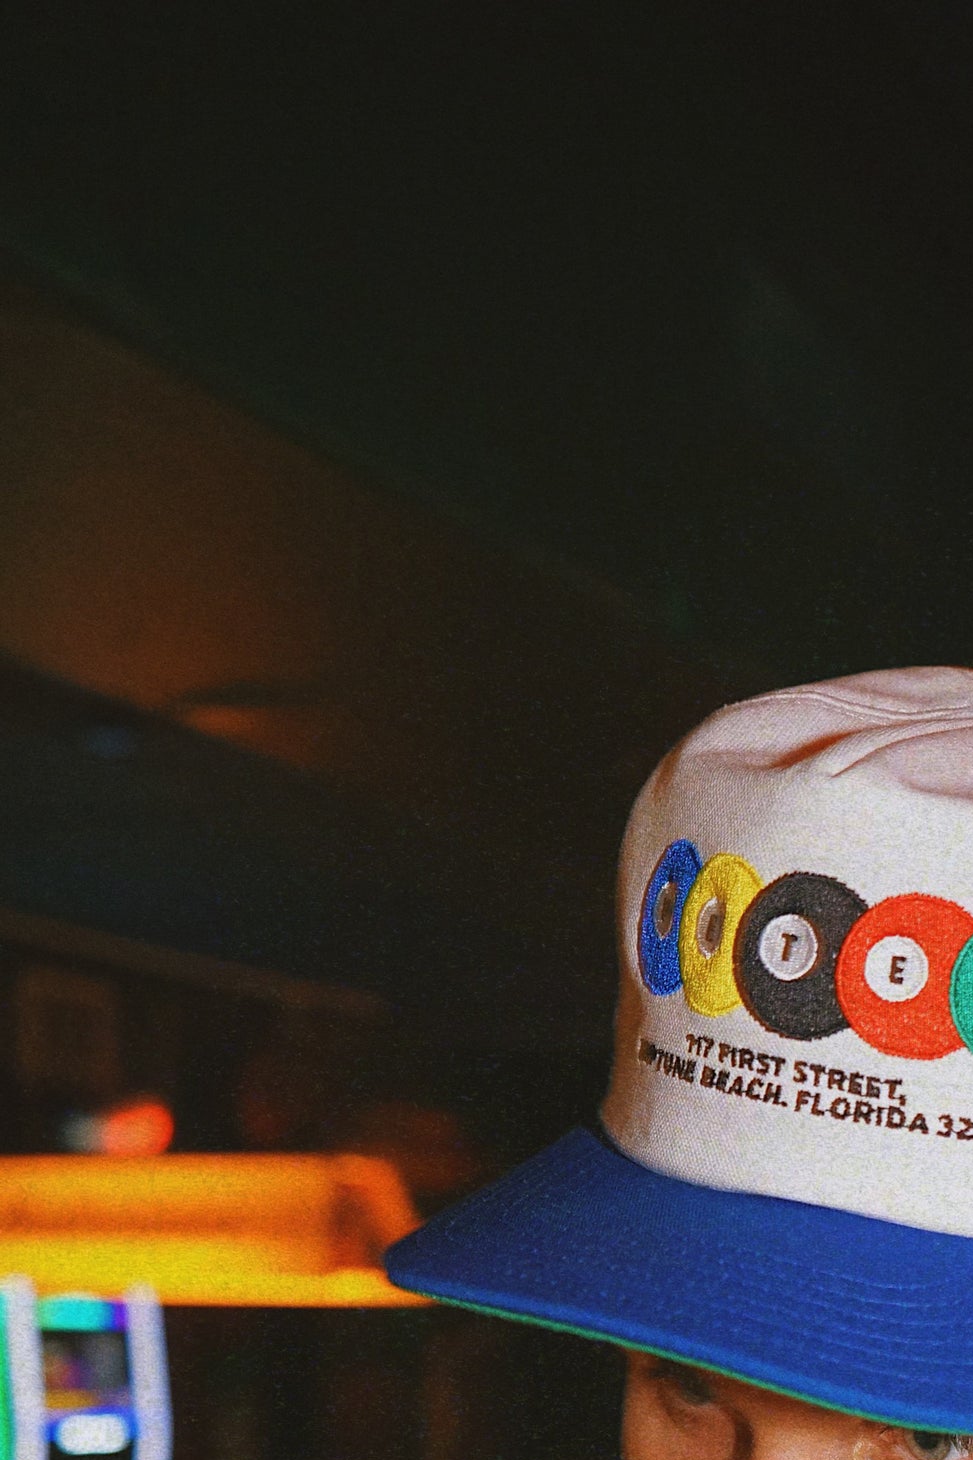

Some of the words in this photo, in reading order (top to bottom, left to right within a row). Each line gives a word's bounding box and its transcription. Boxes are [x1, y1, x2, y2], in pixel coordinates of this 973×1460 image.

[685, 1033, 715, 1059] 117
[718, 1042, 786, 1077] FIRST
[792, 1060, 907, 1107] STREET,
[793, 1090, 929, 1135] FLORIDA
